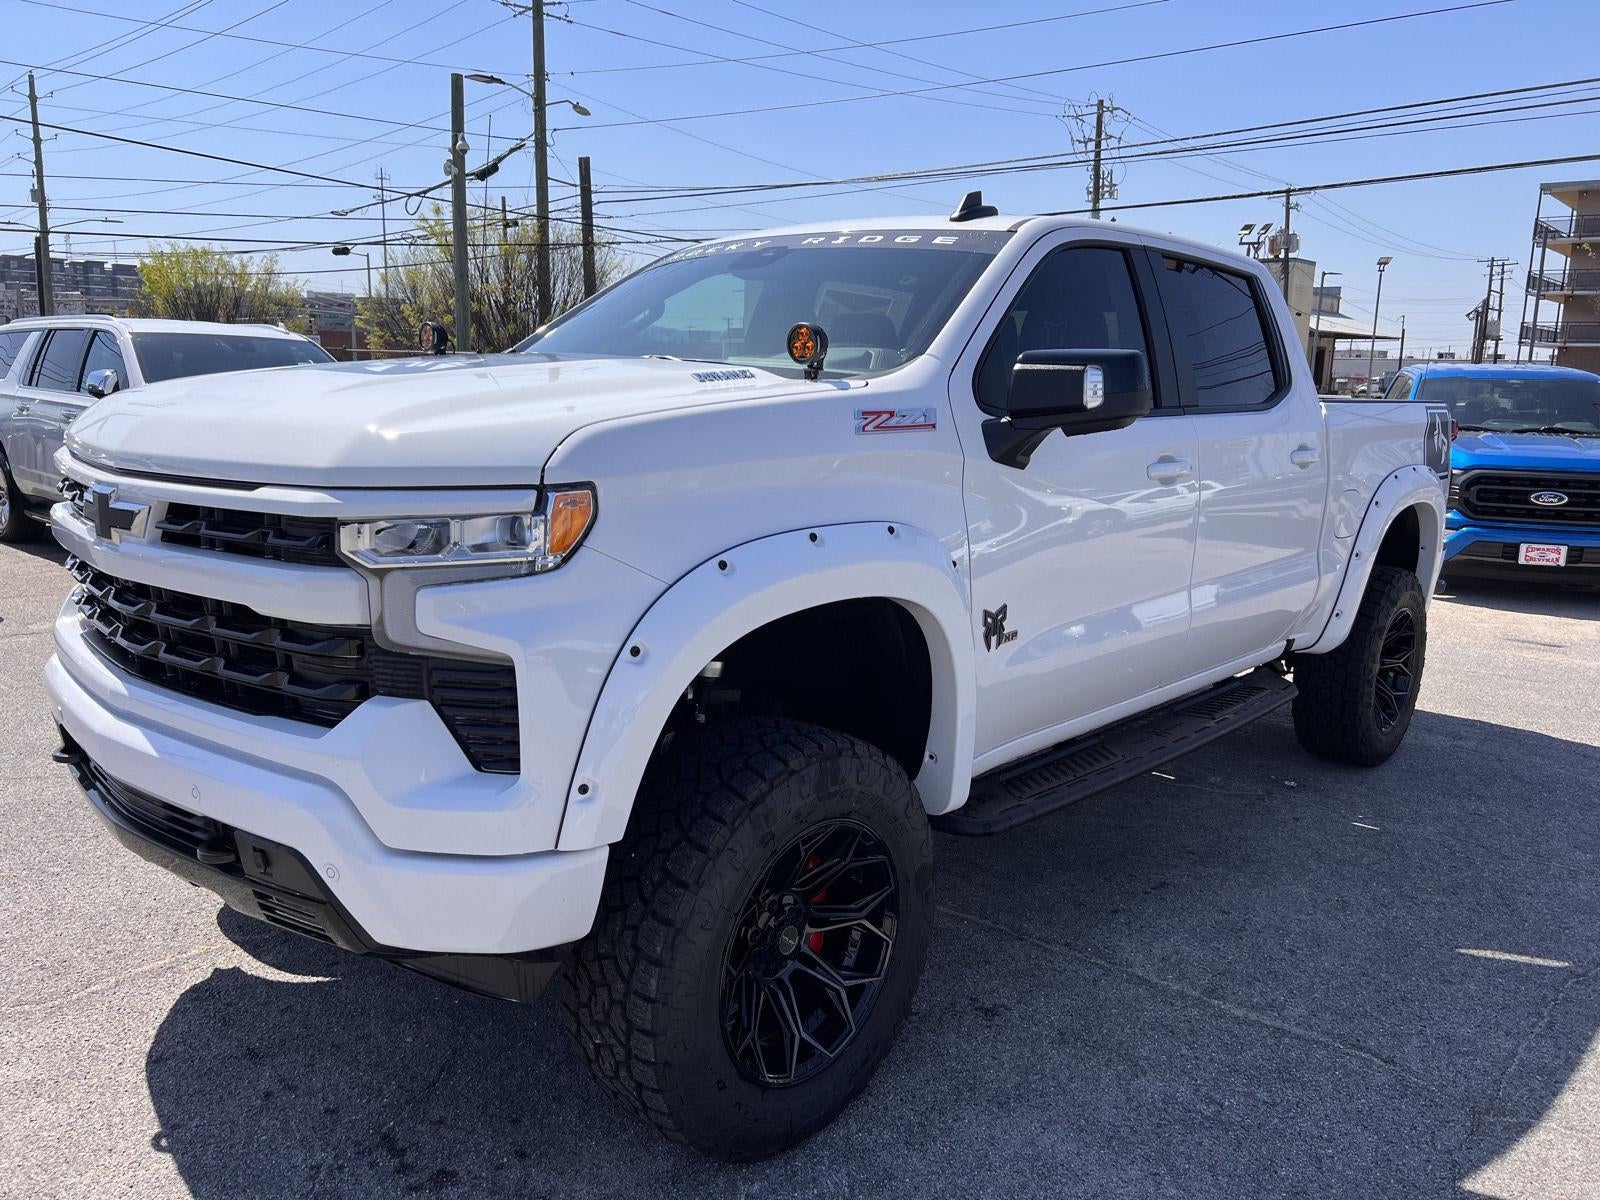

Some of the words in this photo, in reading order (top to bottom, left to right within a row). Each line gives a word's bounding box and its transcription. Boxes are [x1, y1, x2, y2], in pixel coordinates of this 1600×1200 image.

[802, 235, 960, 245] RIDGE
[1539, 494, 1560, 503] Ford
[1526, 546, 1561, 556] EDWARDS
